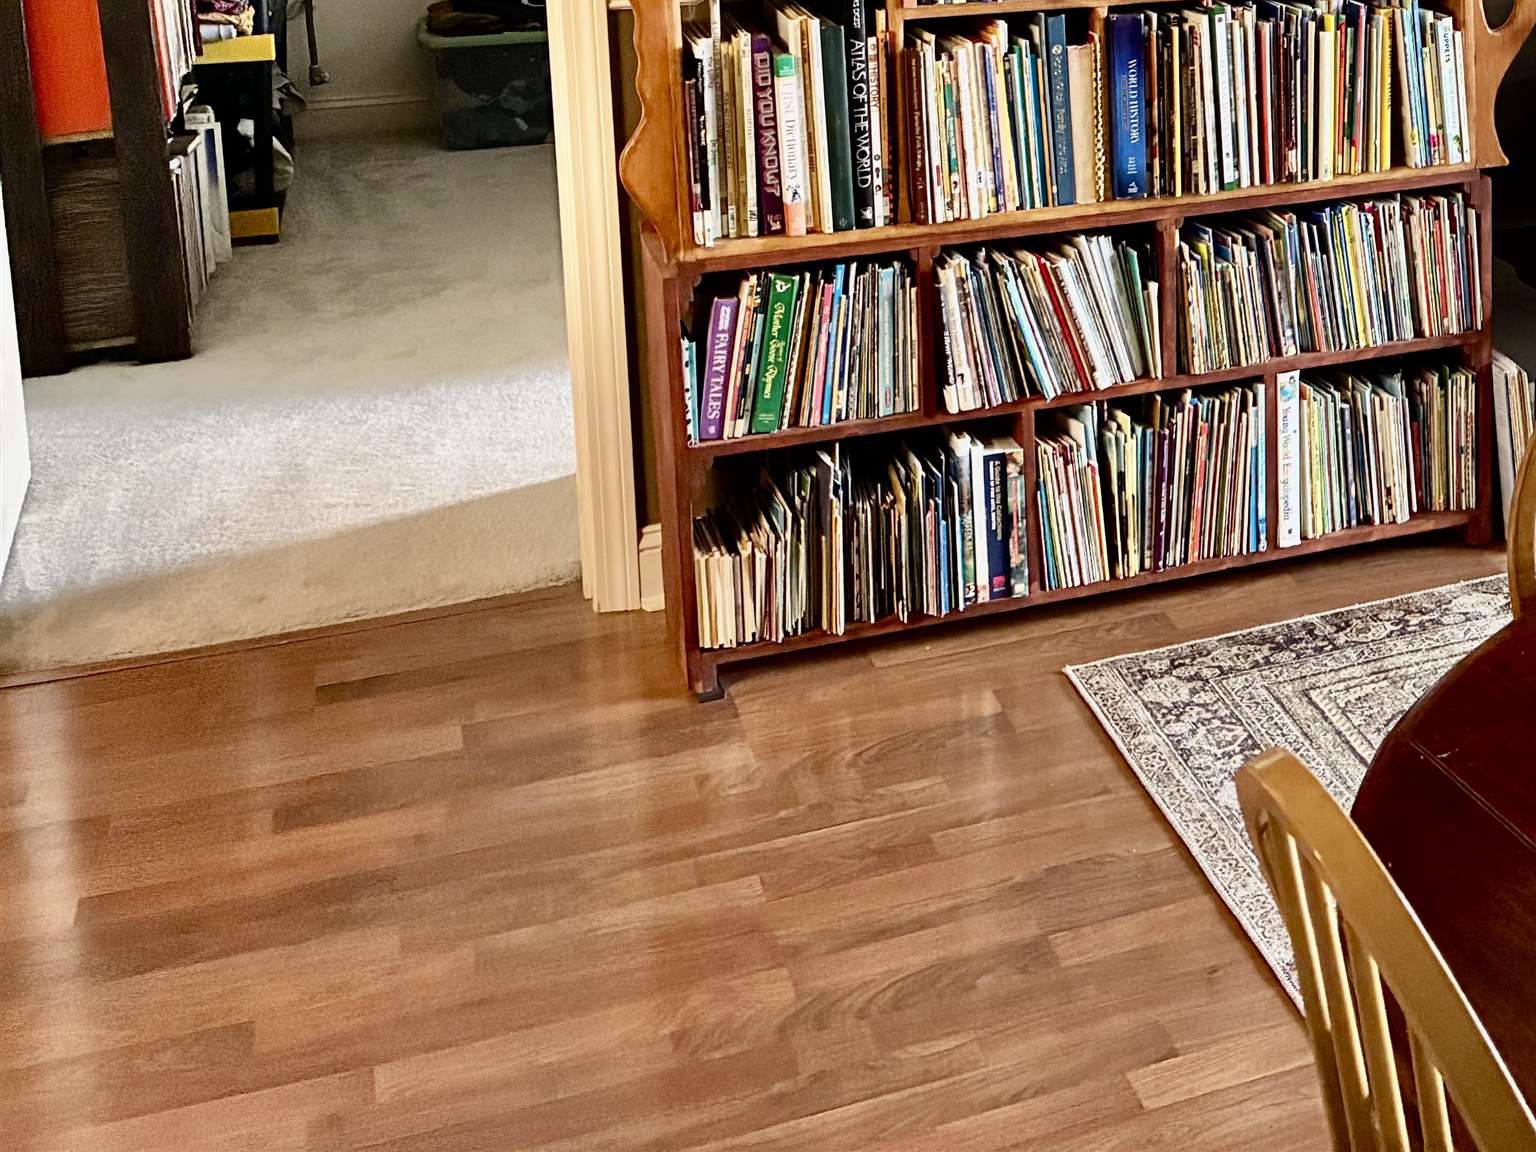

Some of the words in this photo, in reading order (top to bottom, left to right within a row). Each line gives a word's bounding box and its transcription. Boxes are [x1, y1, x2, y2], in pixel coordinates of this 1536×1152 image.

[753, 51, 771, 87] DID
[850, 39, 866, 81] ATLAS
[1127, 58, 1138, 99] WORLD
[756, 87, 775, 128] YOU
[853, 83, 868, 103] OF
[854, 103, 869, 133] THE
[1129, 100, 1140, 144] HISTORY
[856, 131, 872, 188] WORLD
[711, 333, 729, 375] FAIRY
[707, 375, 725, 420] TALES
[1282, 433, 1291, 460] Wold
